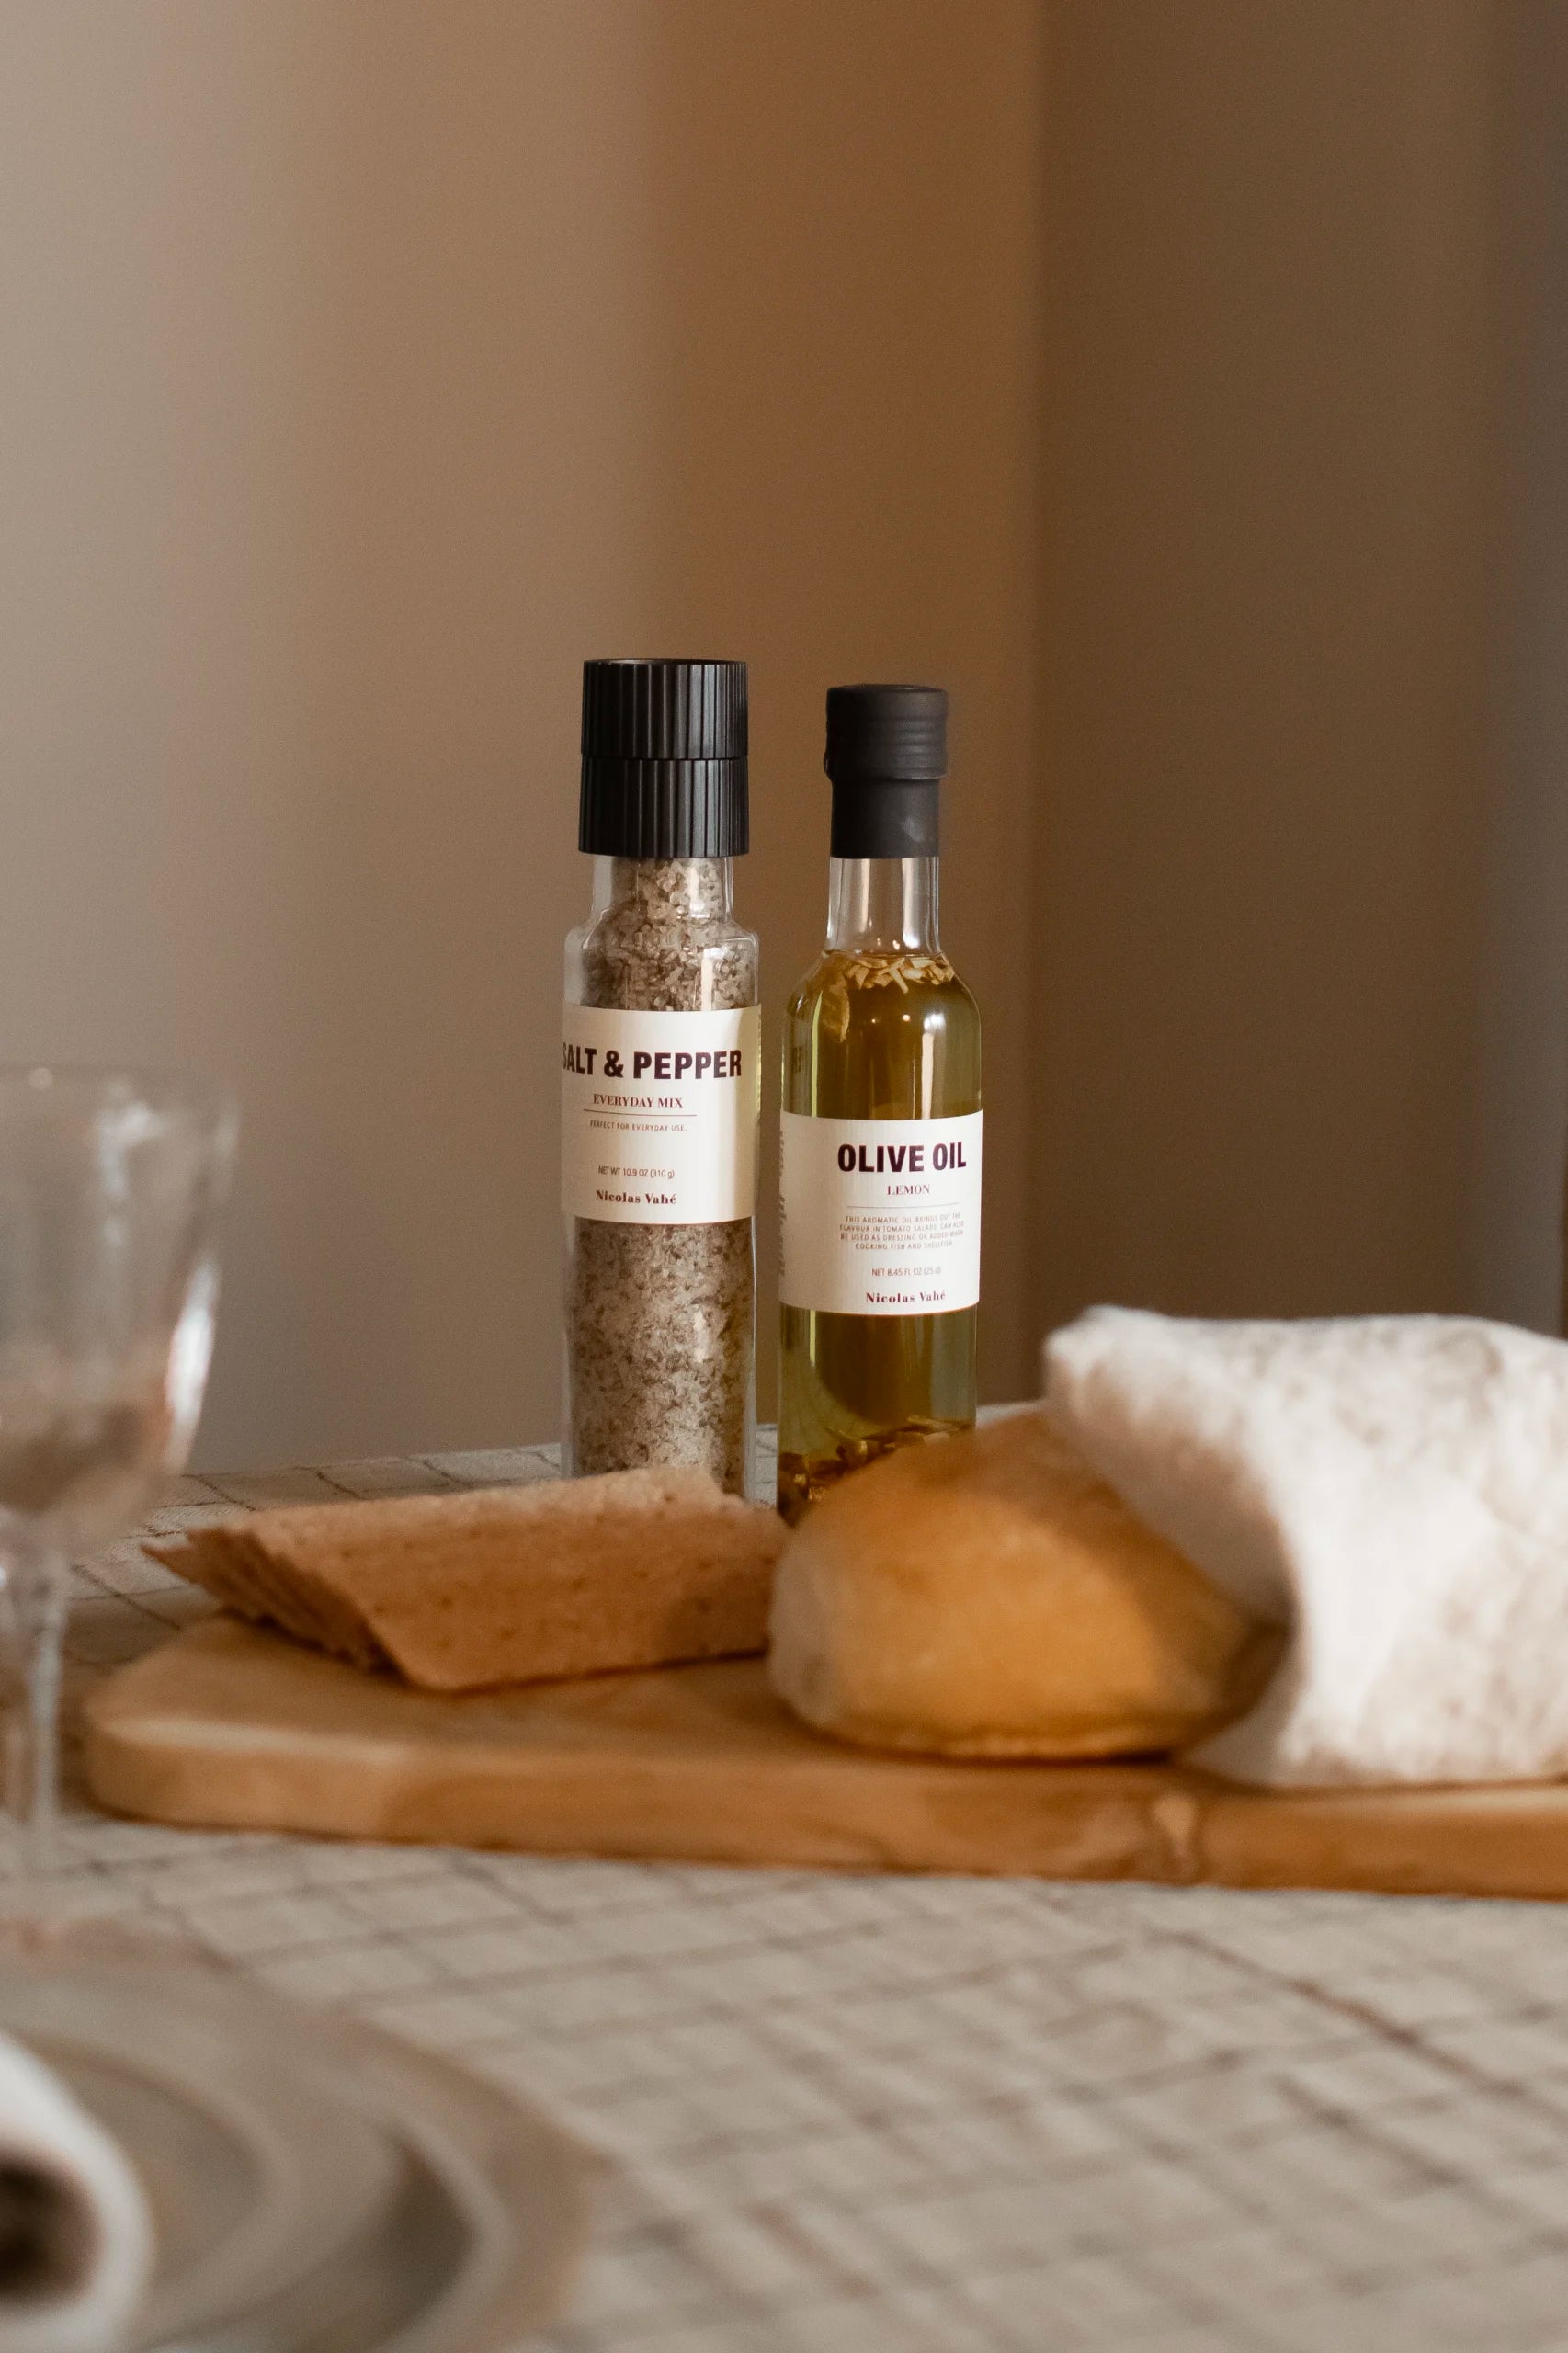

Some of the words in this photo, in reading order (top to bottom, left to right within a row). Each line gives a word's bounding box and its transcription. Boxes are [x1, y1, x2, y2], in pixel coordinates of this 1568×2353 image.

[562, 1042, 597, 1075] SALT
[604, 1050, 624, 1078] &
[633, 1050, 742, 1080] PEPPER
[593, 1093, 655, 1108] EVERYDAY
[657, 1097, 684, 1108] MIX
[590, 1120, 615, 1130] PERFECT
[617, 1121, 630, 1131] FOR
[631, 1123, 668, 1131] EVERYDAY
[837, 1143, 925, 1173] OLIVE
[932, 1142, 967, 1171] OIL
[598, 1165, 609, 1175] NET
[610, 1167, 621, 1176] WT
[623, 1168, 637, 1176] 10.9
[639, 1169, 649, 1177] OZ
[650, 1169, 665, 1178] (310
[887, 1183, 930, 1196] LEMON
[596, 1189, 641, 1204] Nicolas
[644, 1193, 677, 1205] Vahé
[846, 1215, 860, 1223] THIS
[862, 1216, 899, 1224] AROMATIC
[839, 1224, 869, 1233] FLAVOUR
[882, 1233, 916, 1242] DRESSING
[855, 1243, 888, 1251] COOKING
[907, 1242, 922, 1250] AND
[871, 1267, 885, 1277] NET
[887, 1267, 903, 1277] 8.45
[913, 1267, 923, 1276] OZ
[866, 1291, 915, 1303] Nicolas
[919, 1289, 946, 1302] Vahé
